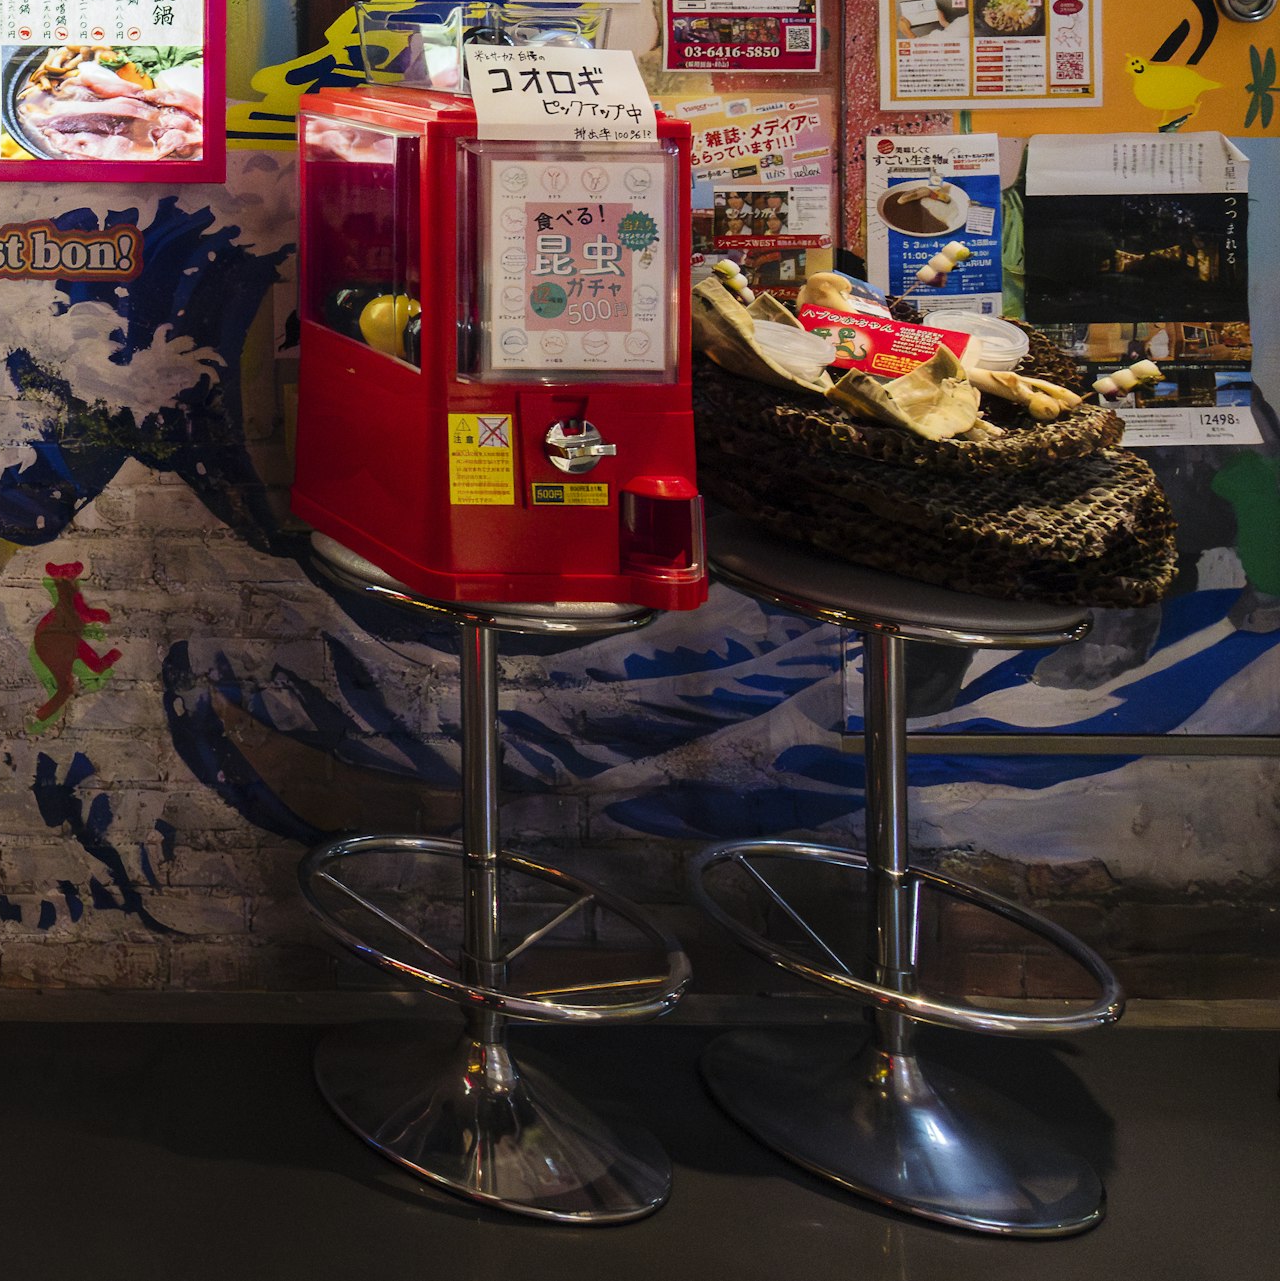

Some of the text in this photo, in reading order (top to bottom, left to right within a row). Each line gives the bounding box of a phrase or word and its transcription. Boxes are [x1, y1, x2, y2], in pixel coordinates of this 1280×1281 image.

[474, 51, 515, 62] 米とサーカス
[685, 46, 780, 57] 03-6416-5850
[488, 66, 603, 96] コオロギ
[542, 99, 642, 125] ピックアップ中
[534, 205, 605, 232] 食べる!
[32, 229, 134, 273] bon!
[530, 233, 625, 277] 昆虫
[567, 278, 622, 298] ガチャ
[568, 299, 628, 325] 500円
[453, 435, 474, 444] 注意
[537, 489, 563, 499] 500円
